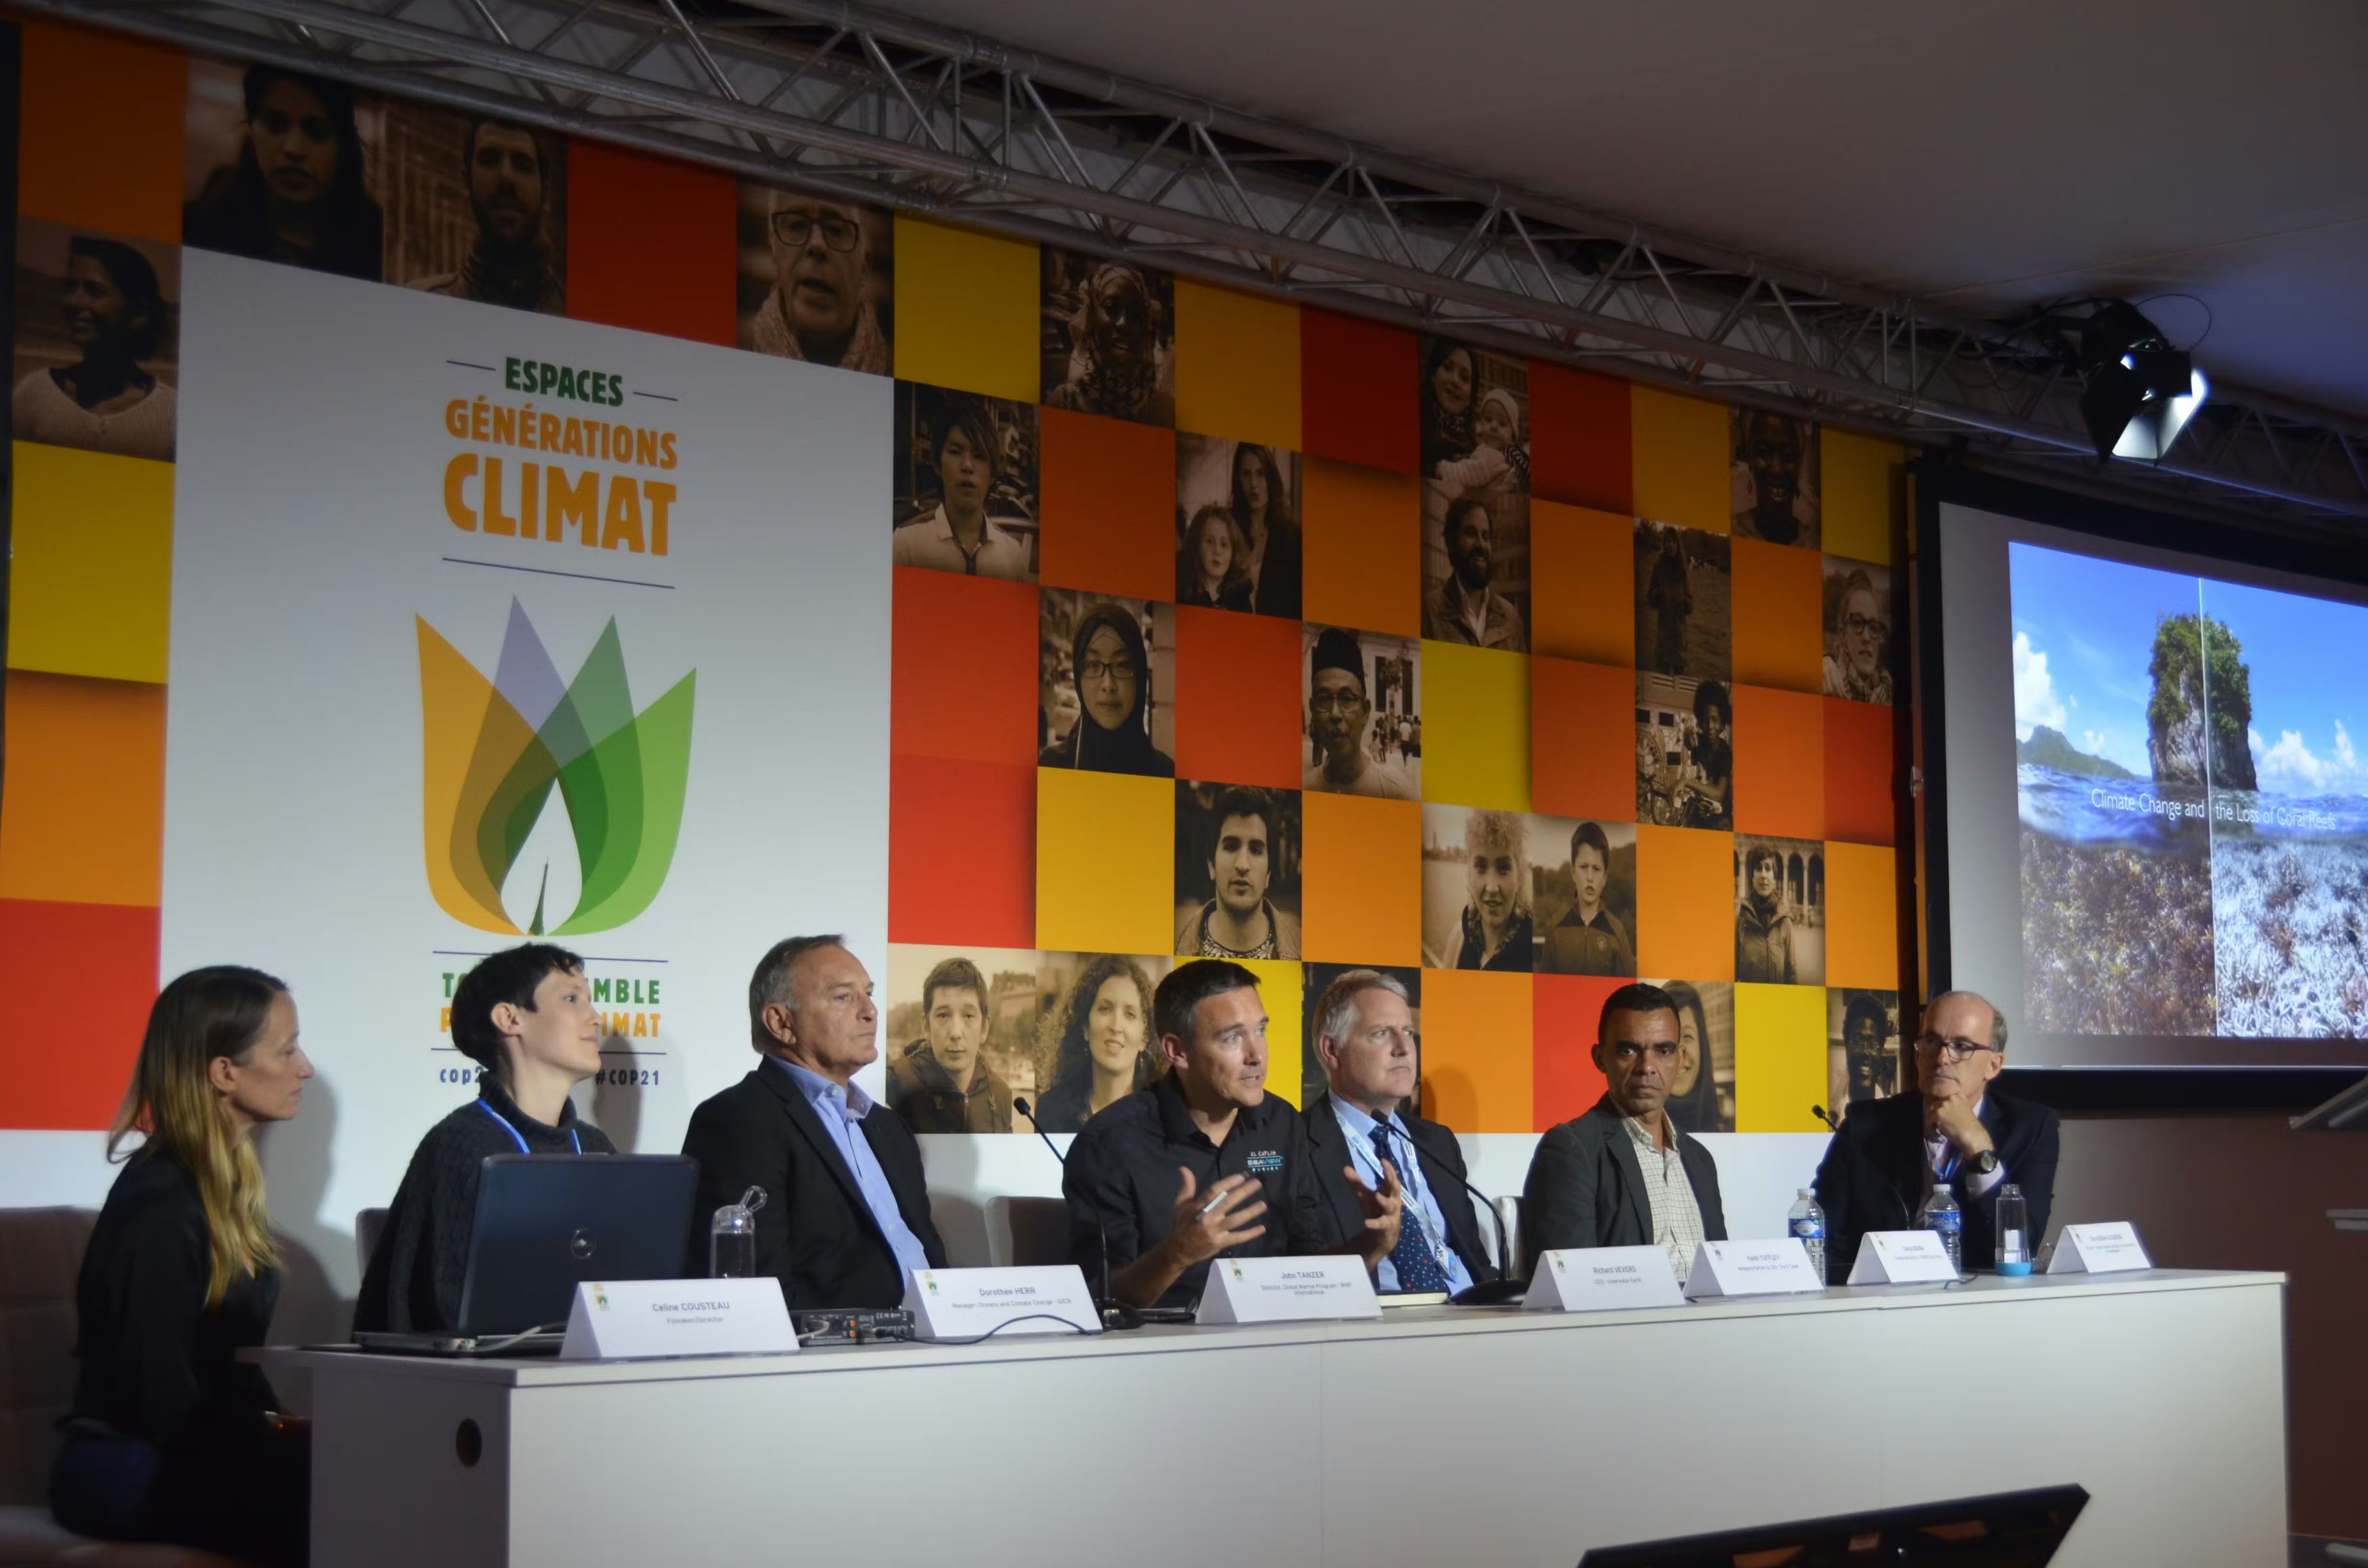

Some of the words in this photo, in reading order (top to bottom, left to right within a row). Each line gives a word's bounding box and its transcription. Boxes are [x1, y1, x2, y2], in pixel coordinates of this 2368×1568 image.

[506, 357, 623, 407] ESPACES
[445, 395, 678, 470] GÉNÉRATIONS
[444, 453, 677, 556] CLIMAT
[2091, 788, 2135, 811] Climate
[2139, 793, 2181, 821] Change
[2184, 799, 2205, 818] and
[2215, 803, 2233, 820] the
[2237, 803, 2259, 822] Loss
[2263, 806, 2275, 825] of
[2277, 807, 2306, 827] Coral
[2309, 810, 2336, 830] Reefs
[587, 977, 660, 1004] MBLE
[602, 1011, 661, 1038] IMAT
[595, 1068, 659, 1086] #COP21
[979, 1288, 1013, 1296] Dorothee
[1014, 1286, 1036, 1295] HERR
[653, 1302, 679, 1311] Celine
[681, 1301, 730, 1311] COUSTEAU
